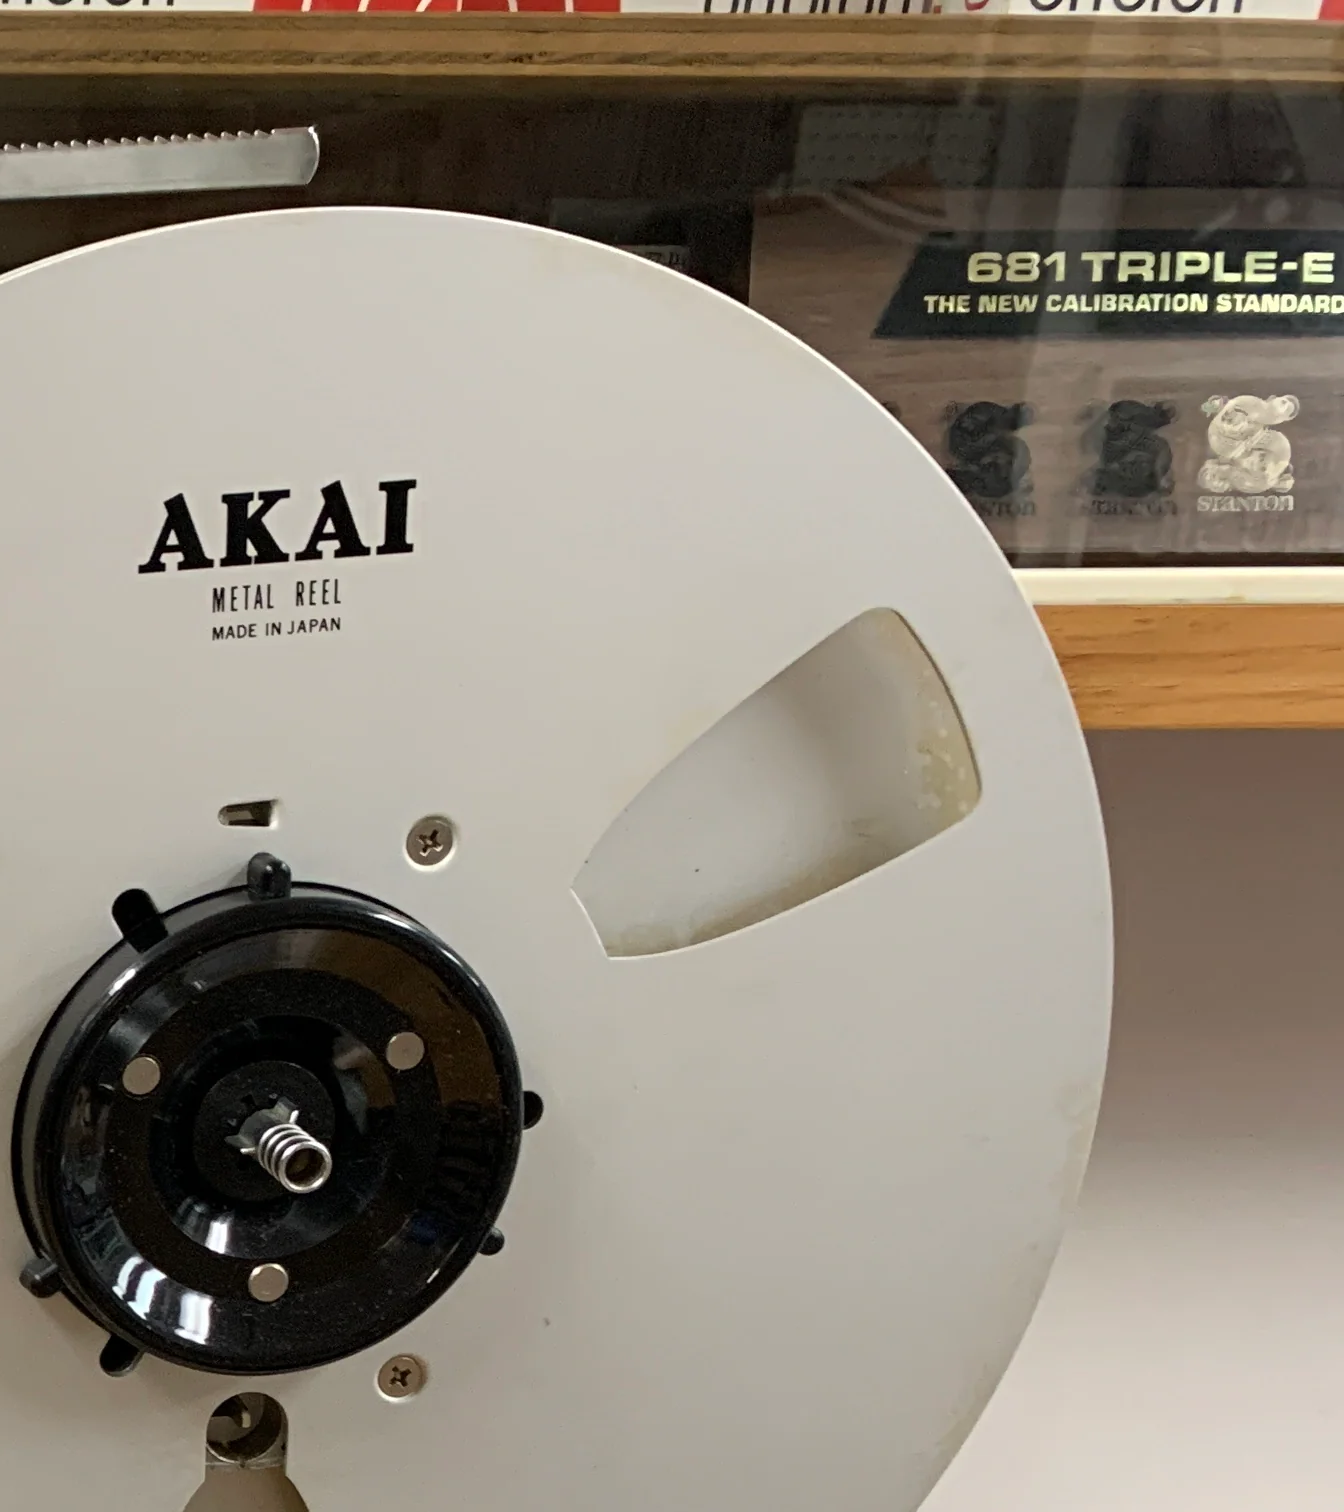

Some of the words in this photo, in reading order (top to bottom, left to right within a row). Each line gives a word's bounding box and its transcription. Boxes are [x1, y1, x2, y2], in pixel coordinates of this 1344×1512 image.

[967, 251, 1067, 283] 681
[1081, 251, 1335, 283] TRIPLE-E
[923, 294, 971, 314] THE
[978, 294, 1039, 313] NEW
[1046, 293, 1208, 313] CALIBRATION
[1216, 293, 1344, 314] STANDARD
[138, 479, 417, 574] AKAI
[212, 583, 274, 613] METAL
[296, 578, 342, 607] REEL
[212, 623, 257, 641] MADE
[265, 621, 282, 637] IN
[287, 617, 342, 635] JAPAN
